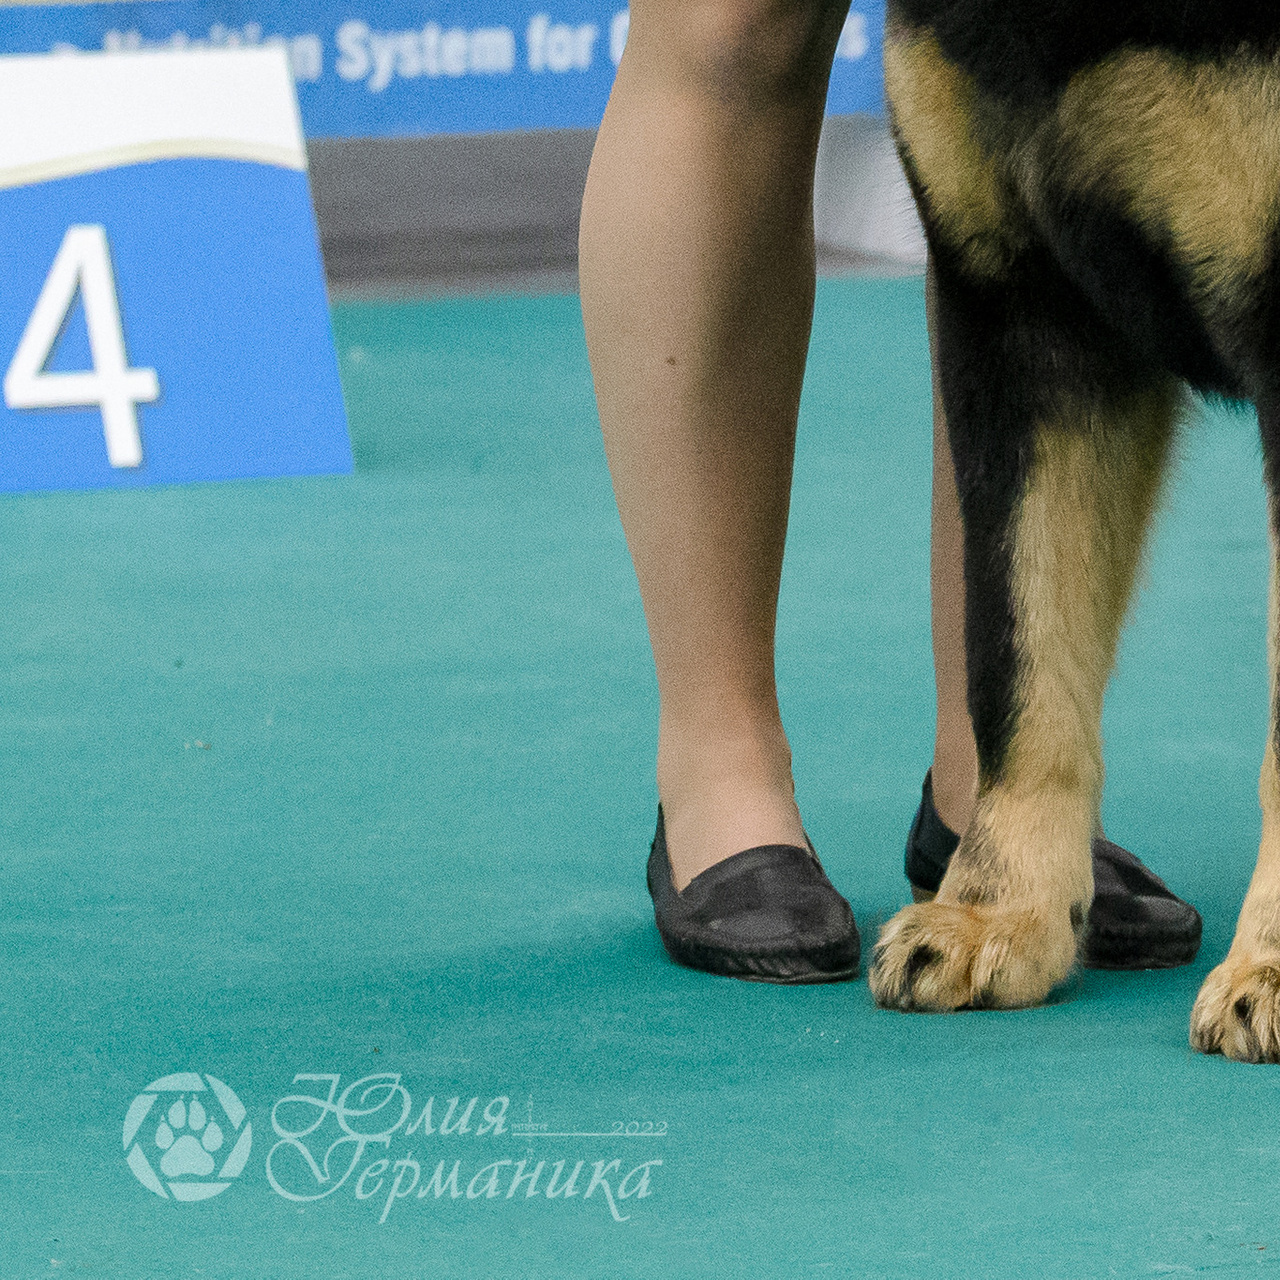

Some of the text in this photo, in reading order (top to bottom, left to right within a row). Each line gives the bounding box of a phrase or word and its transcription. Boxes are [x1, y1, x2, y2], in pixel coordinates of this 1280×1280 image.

[335, 19, 516, 92] System
[527, 13, 596, 74] for
[4, 224, 160, 468] 4
